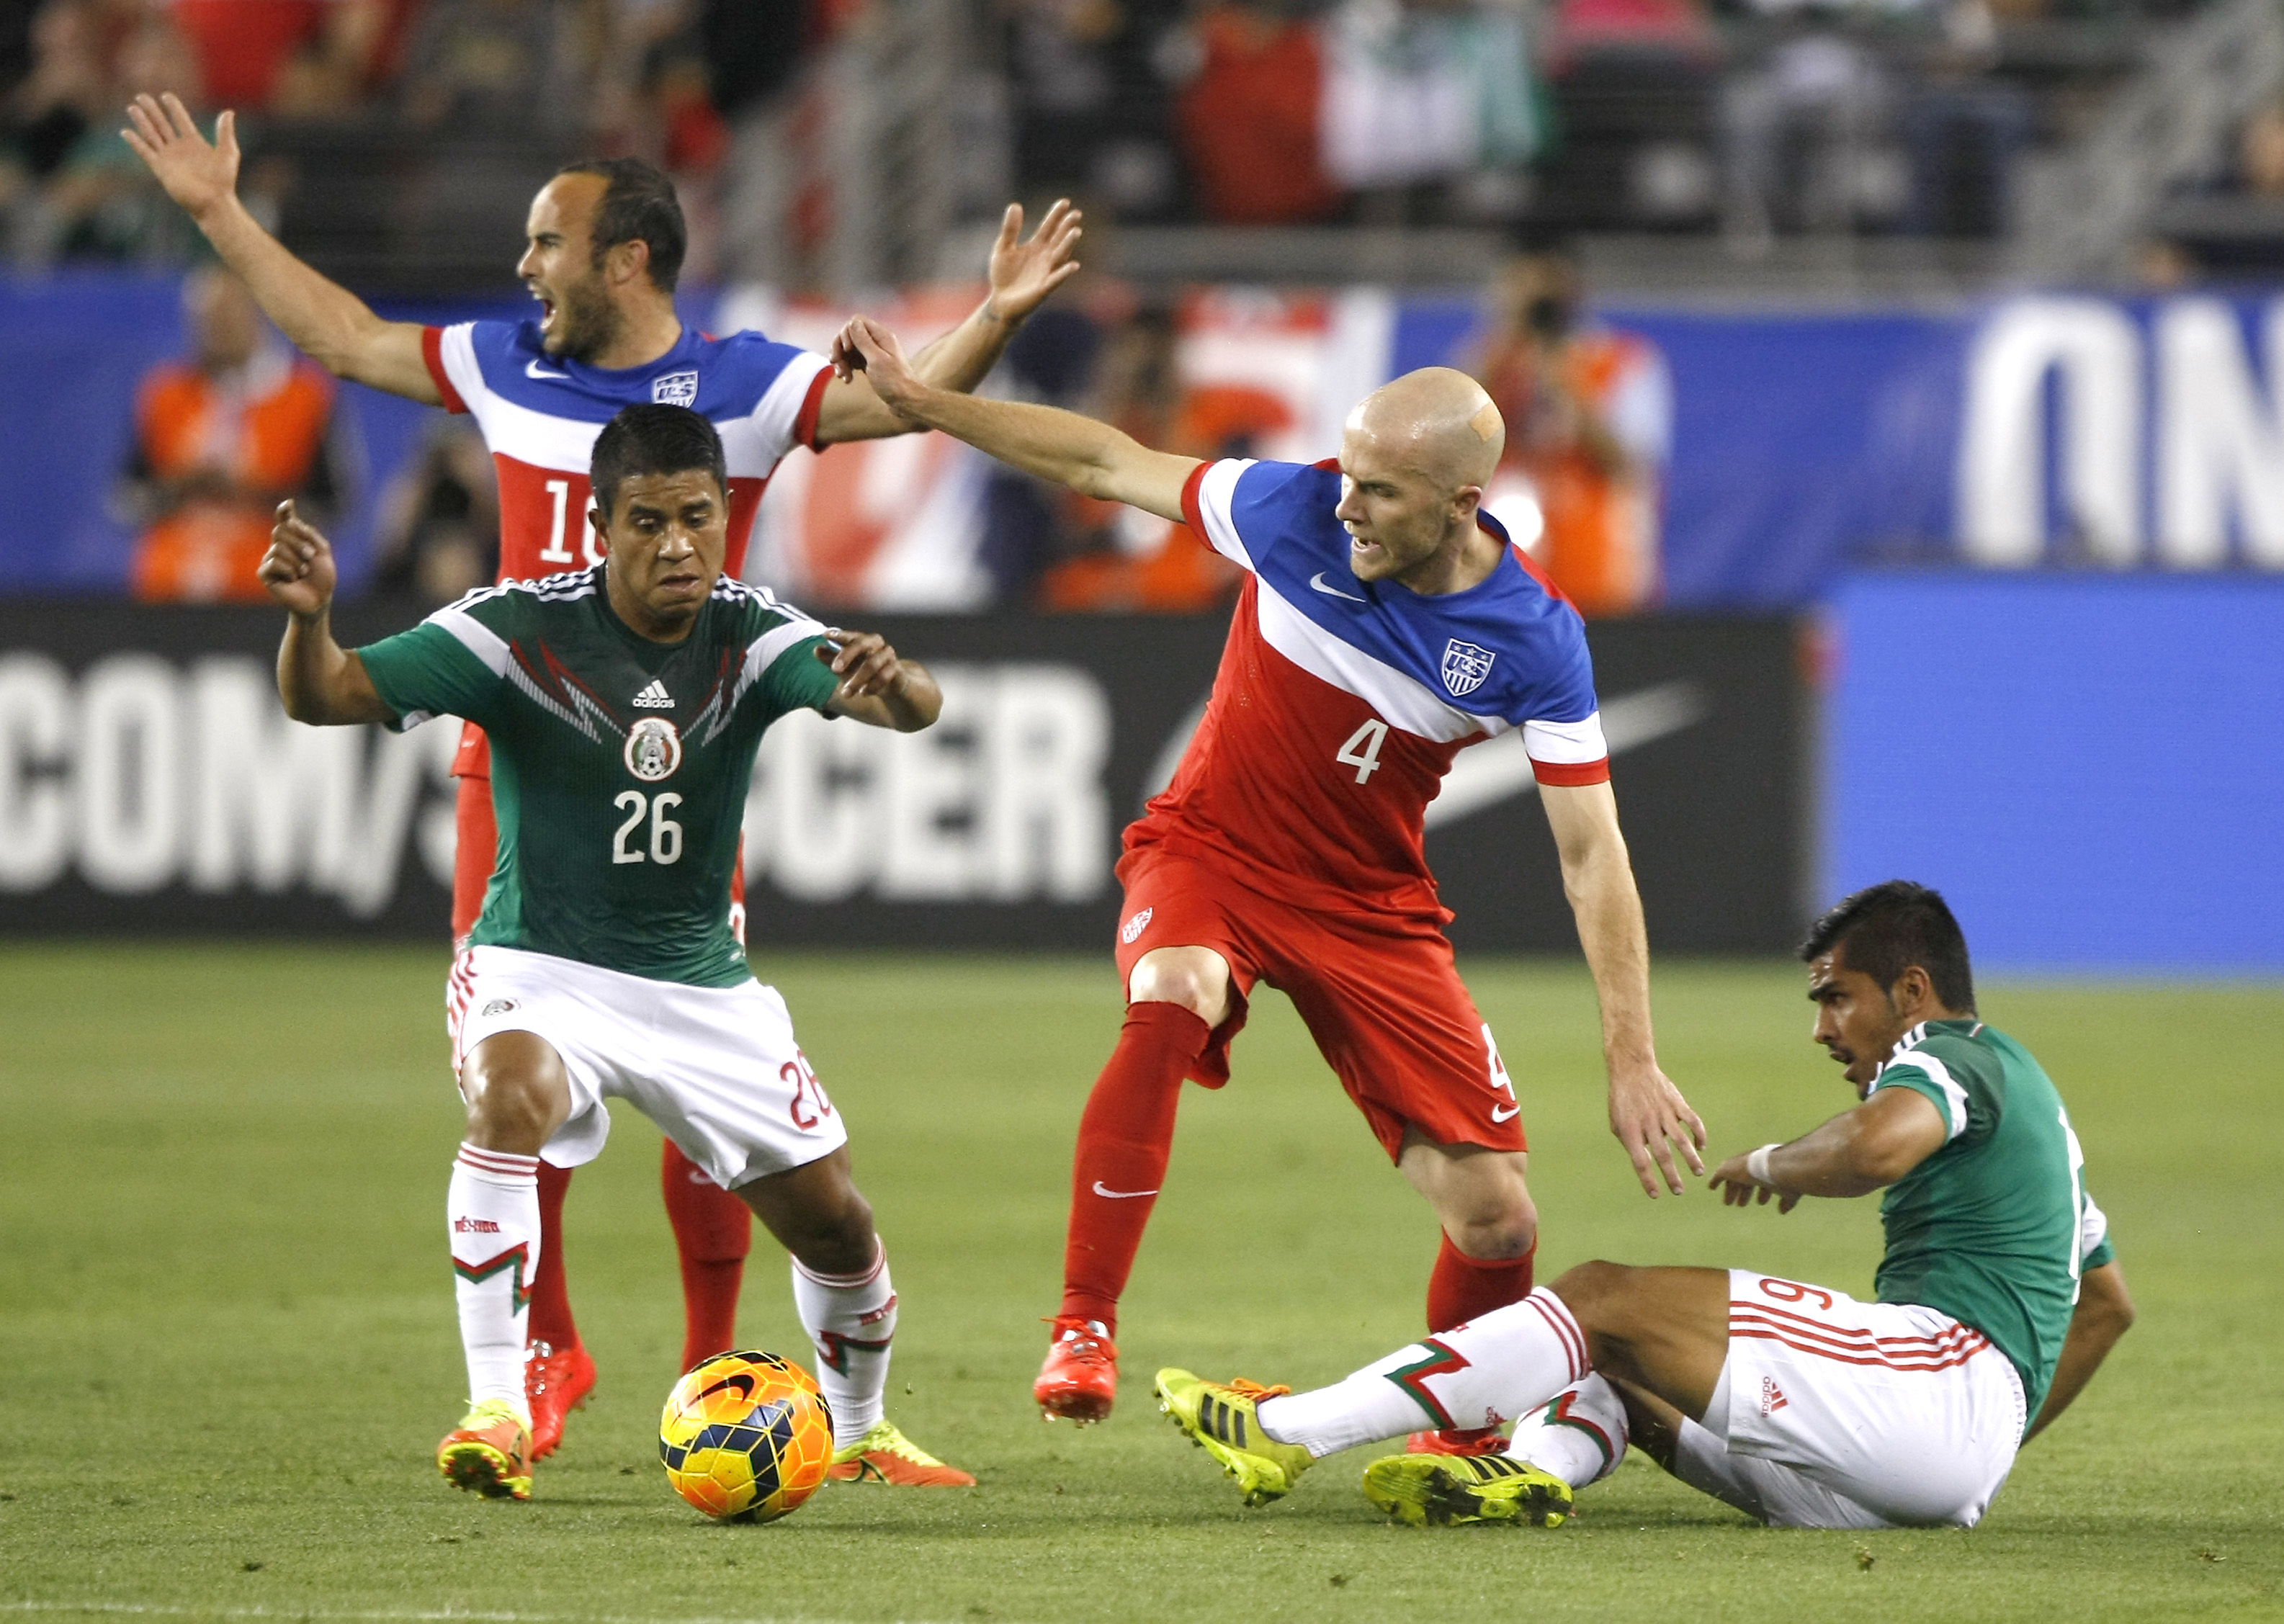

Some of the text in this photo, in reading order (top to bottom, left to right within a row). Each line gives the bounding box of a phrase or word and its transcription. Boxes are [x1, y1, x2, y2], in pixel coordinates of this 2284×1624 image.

[632, 697, 675, 709] adidas
[1336, 718, 1389, 784] 4
[613, 790, 683, 864] 26
[1481, 1023, 1516, 1102] 4
